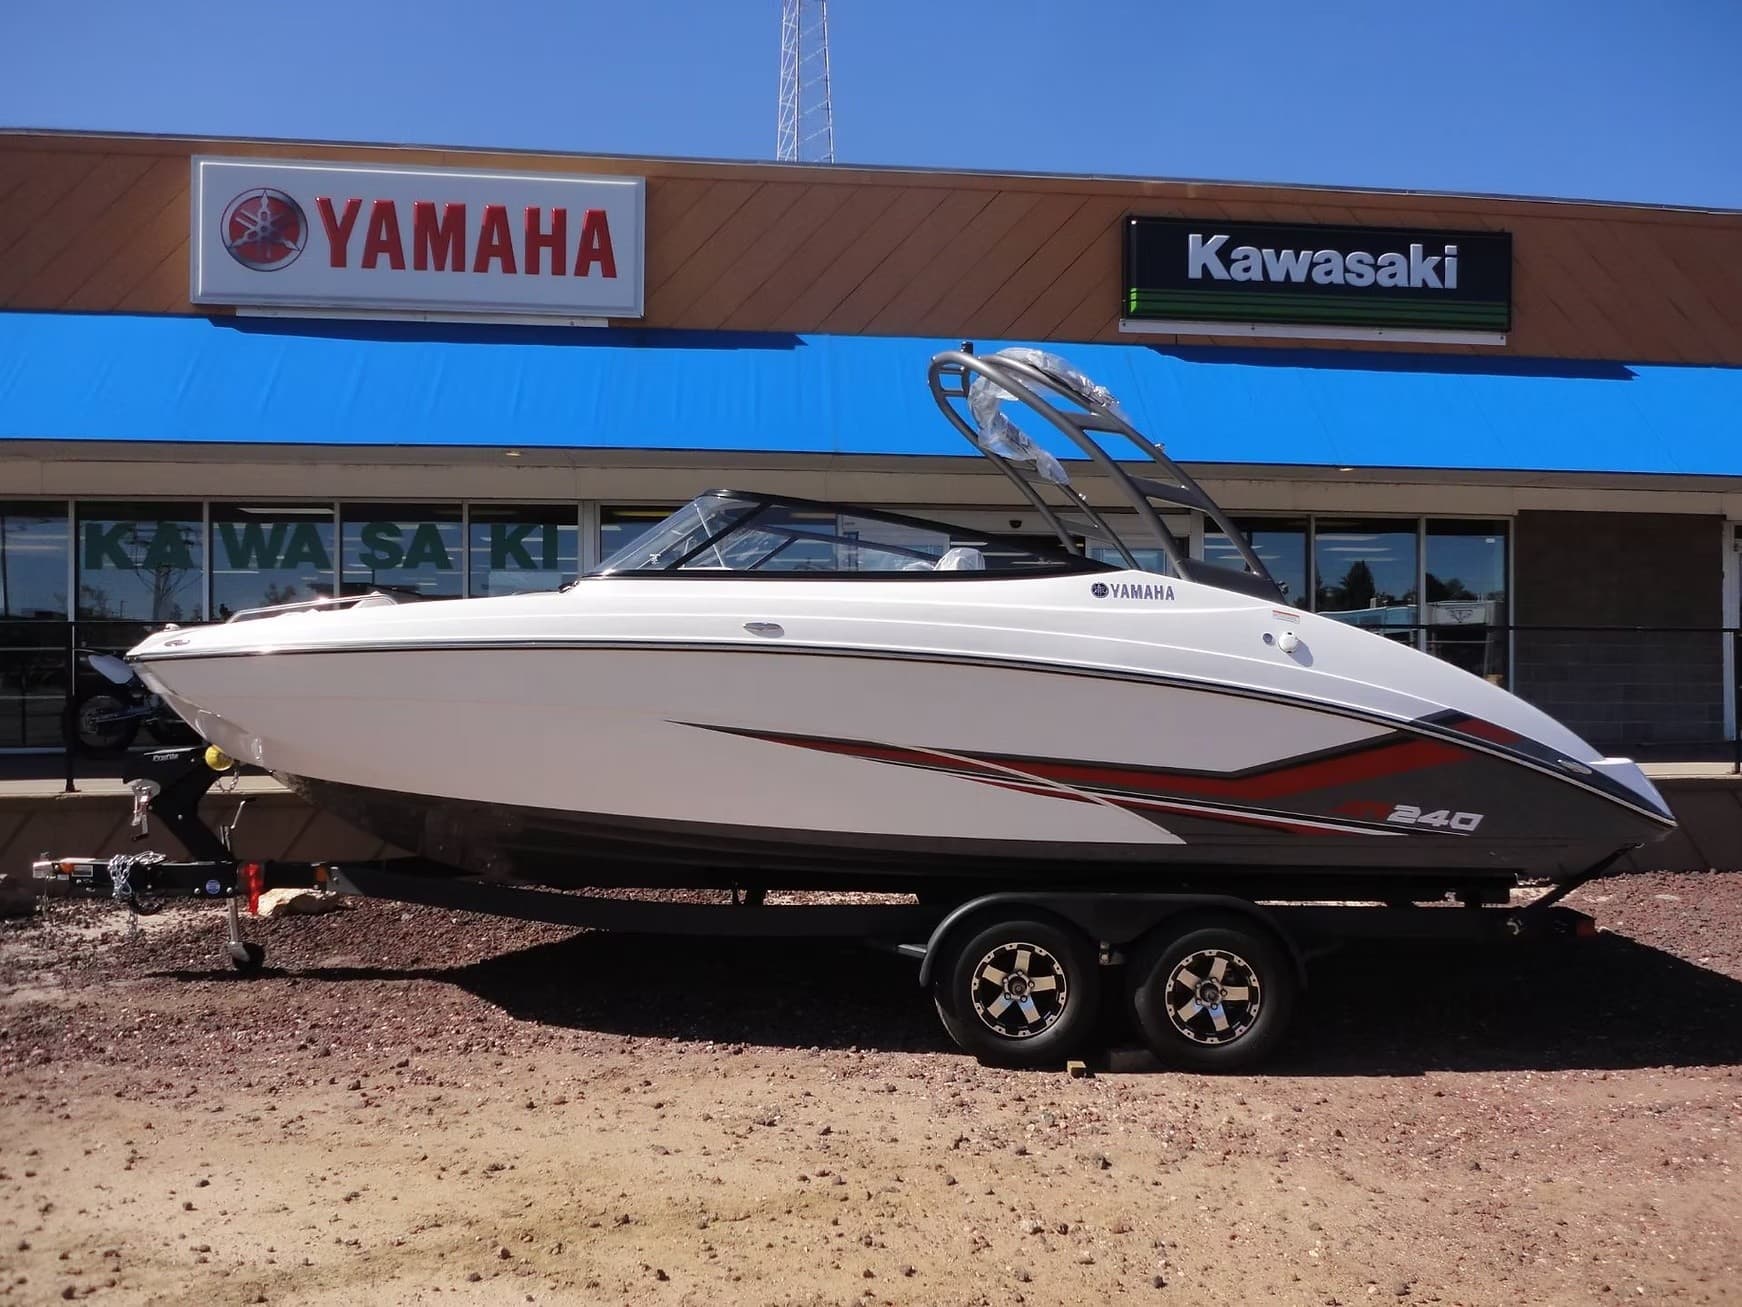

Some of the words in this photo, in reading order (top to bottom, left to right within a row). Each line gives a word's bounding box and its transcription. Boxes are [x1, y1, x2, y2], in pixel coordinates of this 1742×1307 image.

[315, 196, 618, 279] YAMAHA
[1187, 233, 1459, 290] Kawasaki
[1110, 583, 1175, 601] YAMAHA
[1386, 804, 1485, 832] 240
